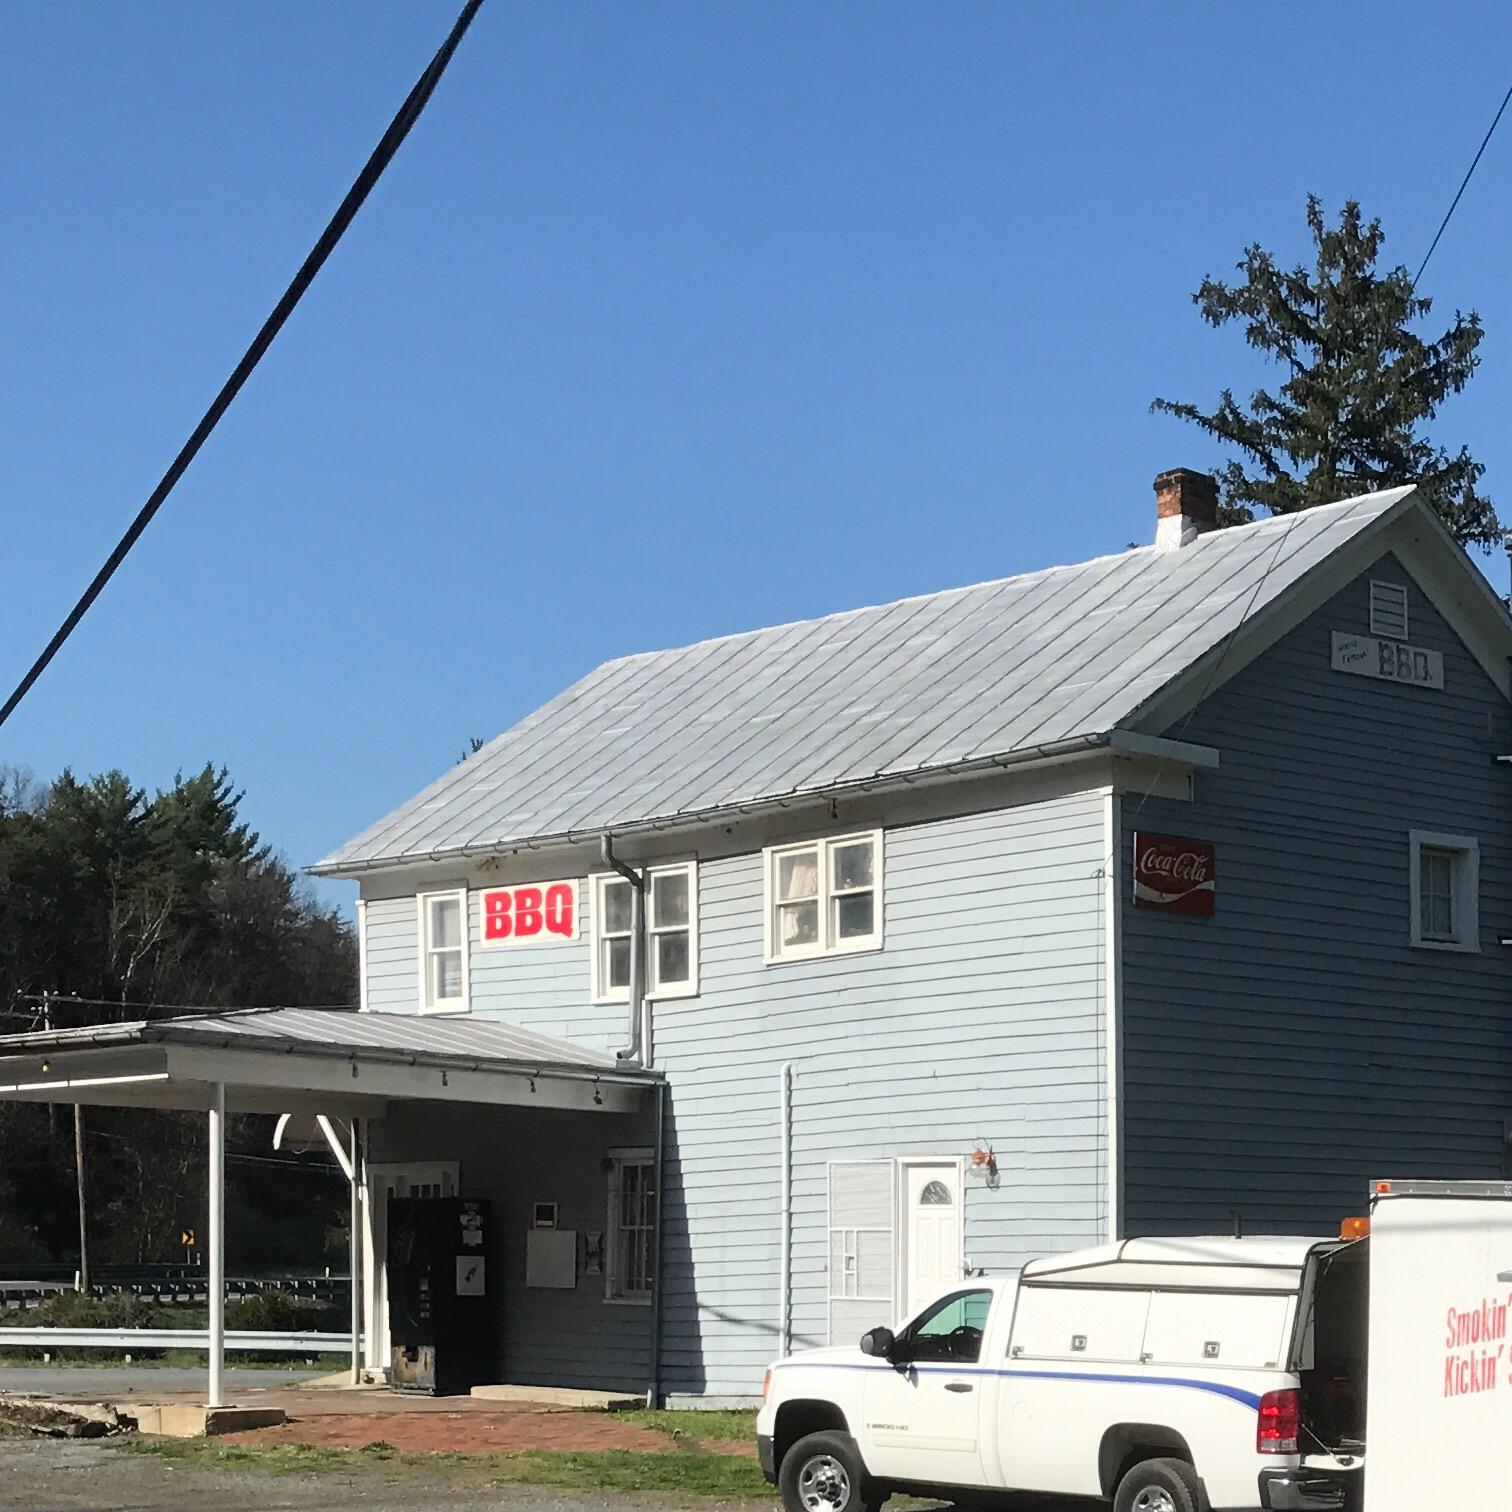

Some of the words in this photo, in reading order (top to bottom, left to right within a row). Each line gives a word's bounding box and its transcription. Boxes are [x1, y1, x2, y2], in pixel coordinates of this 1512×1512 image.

[1378, 640, 1433, 682] BBQ
[1140, 847, 1209, 881] Coca-Cola
[484, 883, 574, 940] BBQ
[1444, 1344, 1504, 1398] Kickin'
